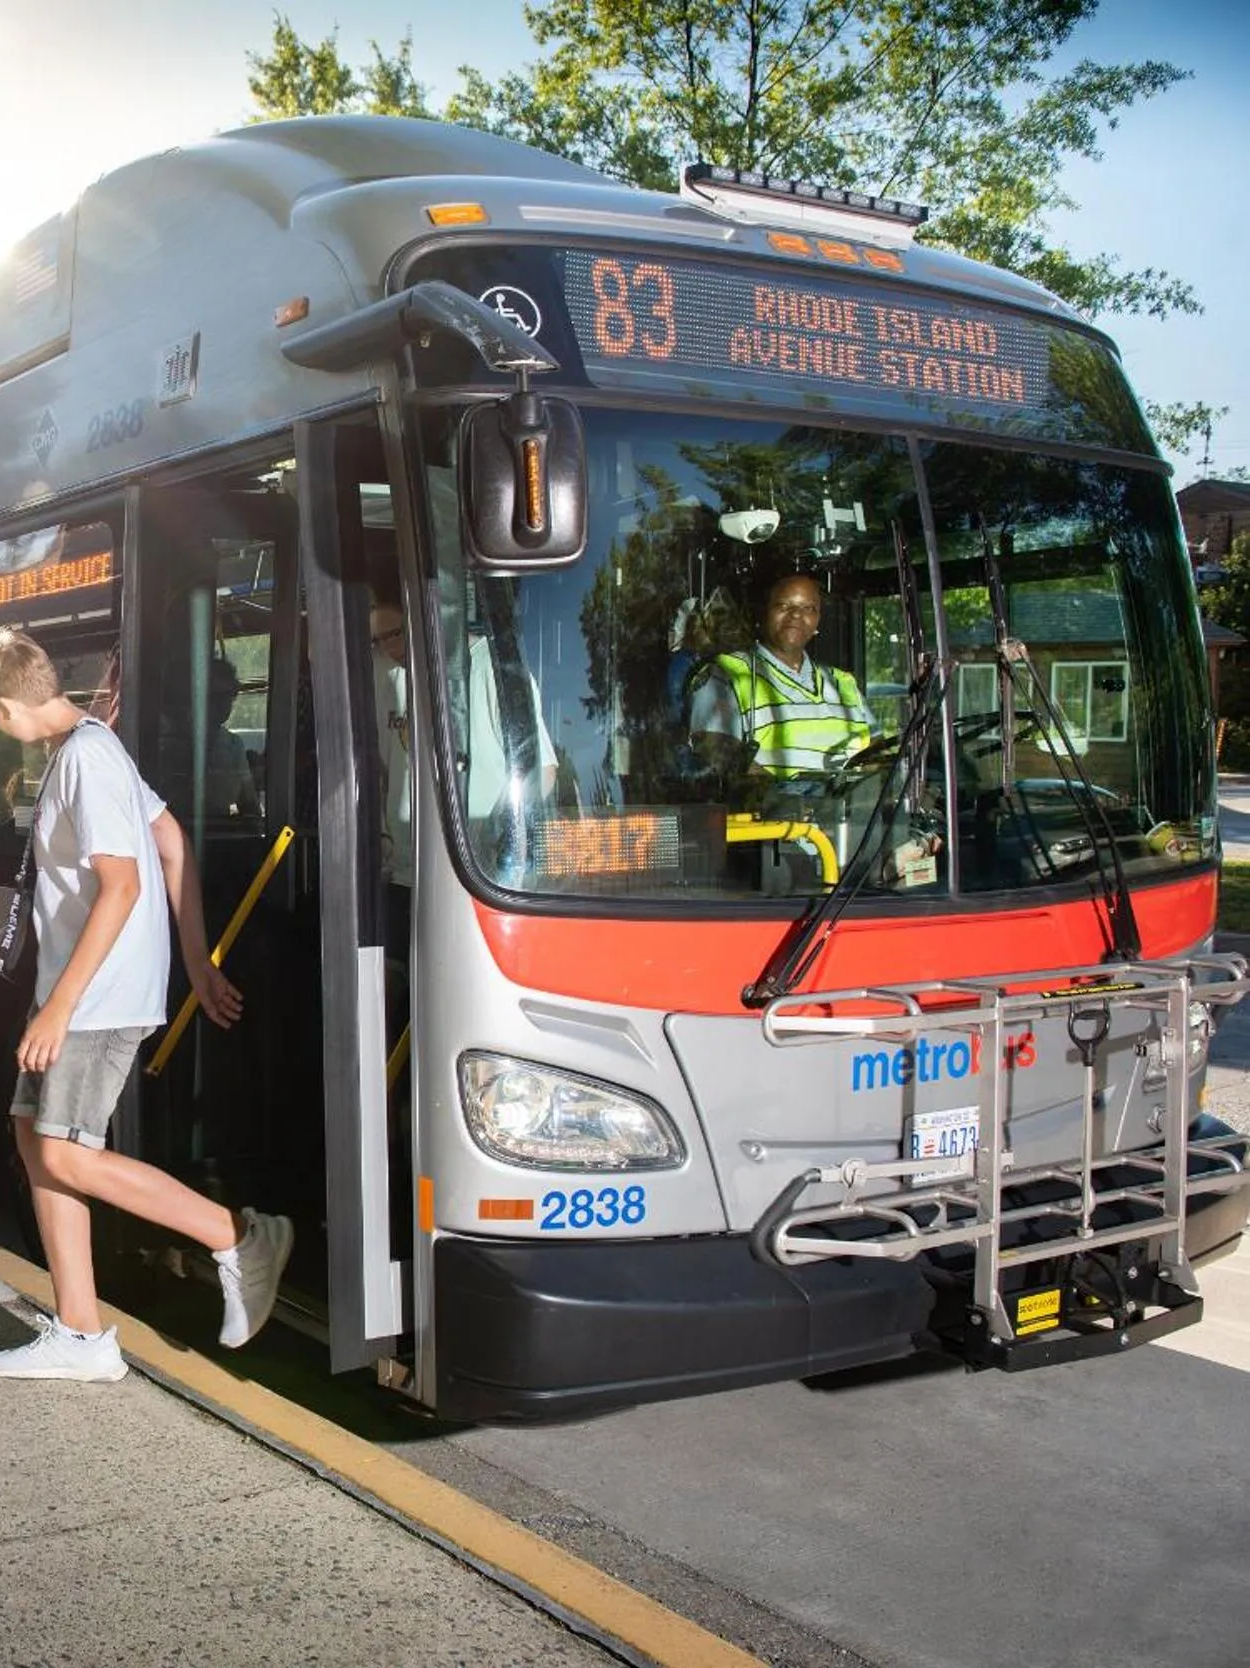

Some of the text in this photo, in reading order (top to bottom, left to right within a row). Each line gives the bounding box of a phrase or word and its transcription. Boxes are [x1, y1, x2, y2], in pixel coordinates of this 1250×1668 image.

[591, 256, 678, 360] 83
[754, 283, 998, 356] RHODE ISLAND
[729, 326, 1026, 403] AVENUE STATION
[86, 399, 145, 453] 2838
[19, 569, 38, 598] IN
[42, 552, 112, 592] SERVICE
[539, 1185, 646, 1230] 2838
